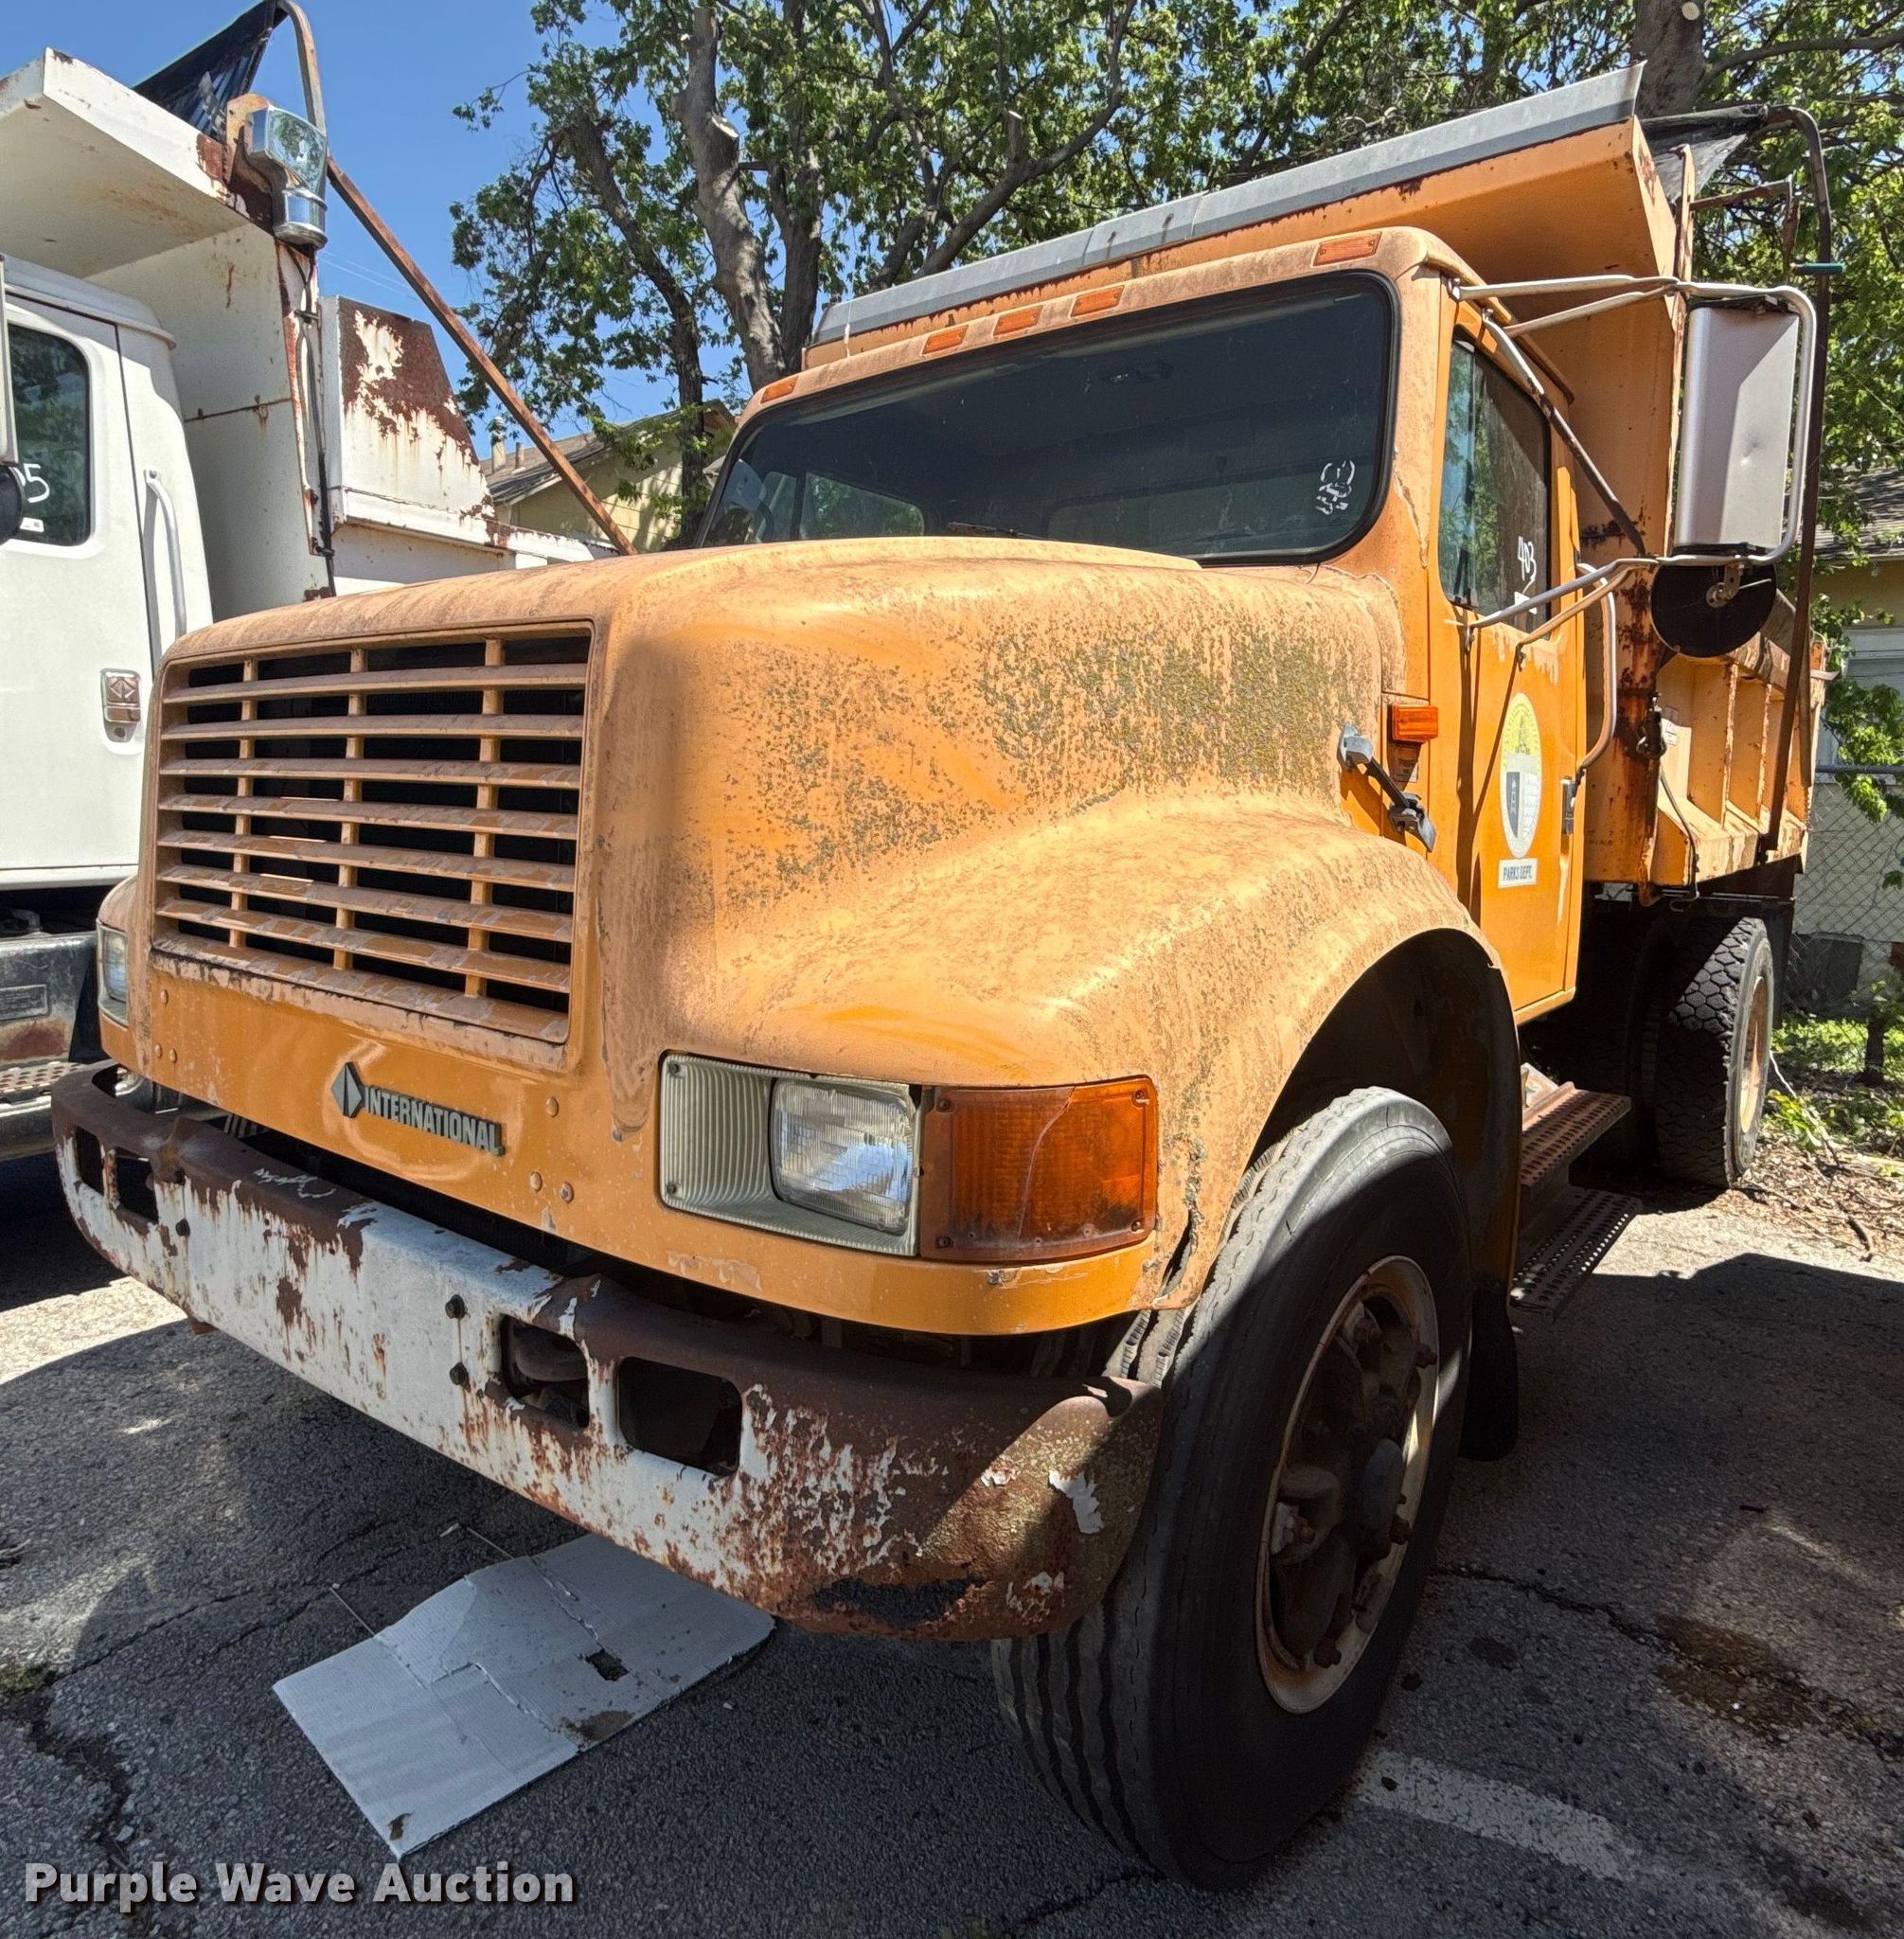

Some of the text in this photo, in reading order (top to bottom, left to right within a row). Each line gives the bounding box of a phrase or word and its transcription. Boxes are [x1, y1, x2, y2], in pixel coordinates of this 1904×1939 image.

[1518, 536, 1537, 594] 403
[1503, 866, 1520, 881] PARKS
[365, 1086, 504, 1156] INTERNATIONAL
